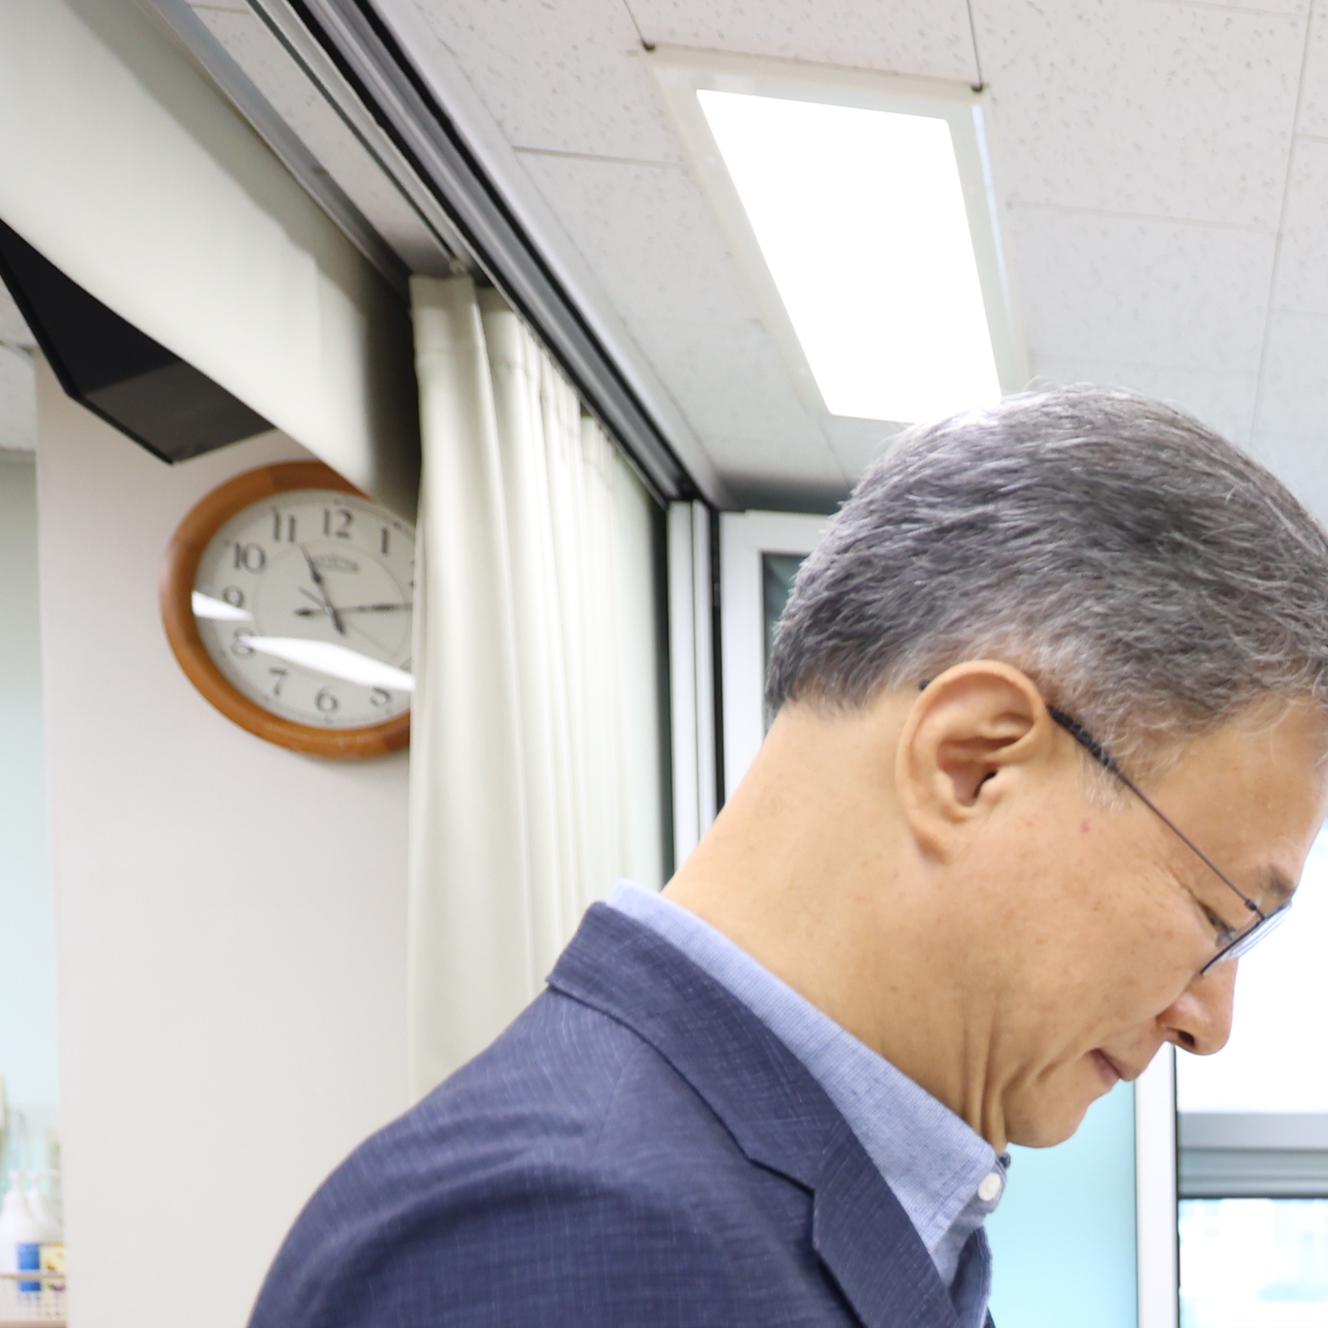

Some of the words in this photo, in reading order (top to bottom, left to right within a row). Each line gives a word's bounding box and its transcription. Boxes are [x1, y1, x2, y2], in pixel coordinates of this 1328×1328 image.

[271, 508, 297, 543] 11
[323, 509, 353, 539] 12
[381, 527, 390, 555] 1
[234, 542, 266, 574] 10
[222, 587, 245, 609] 9
[268, 668, 288, 697] 7
[314, 687, 340, 713] 6
